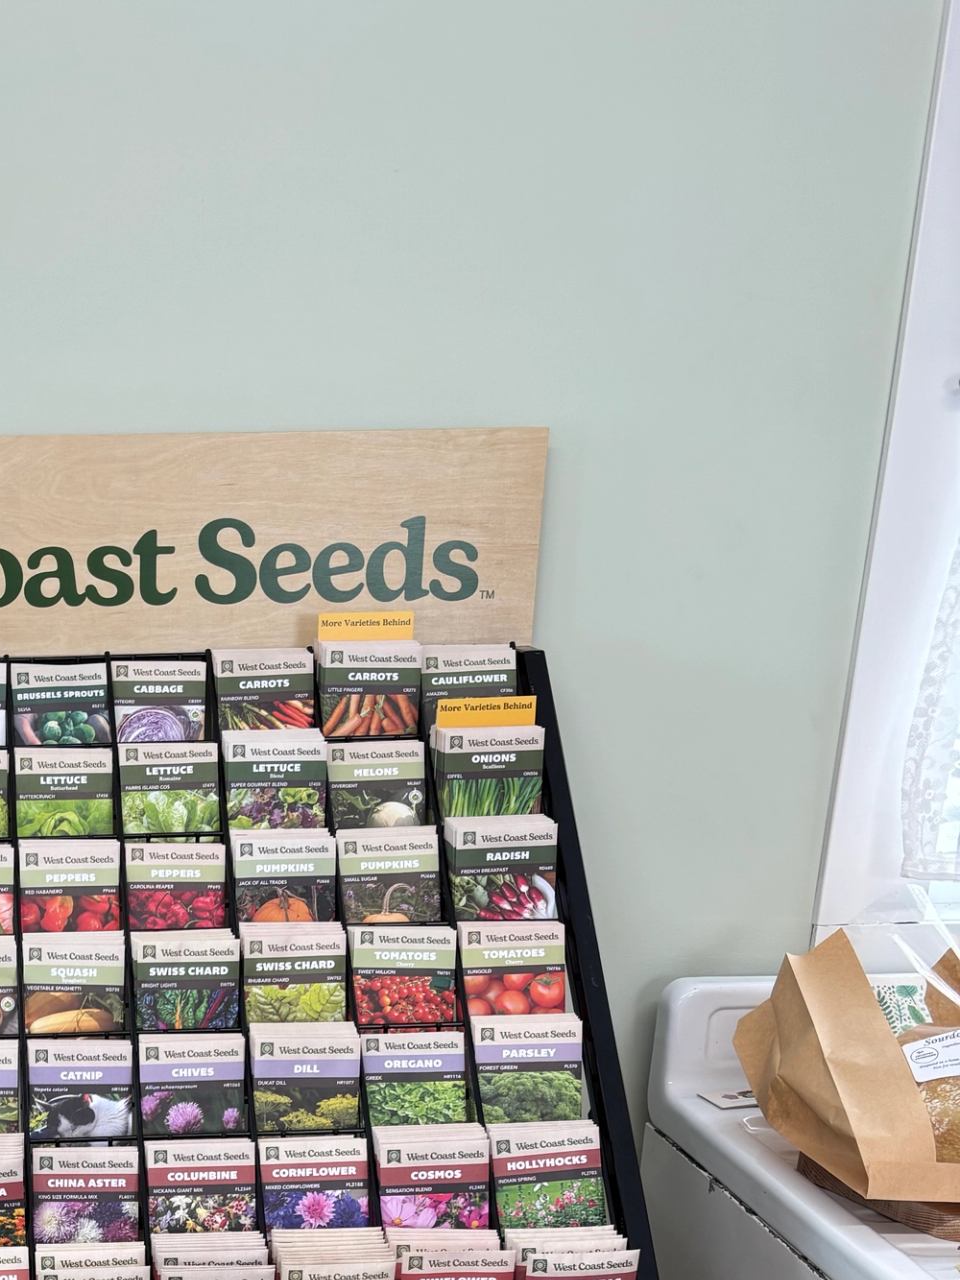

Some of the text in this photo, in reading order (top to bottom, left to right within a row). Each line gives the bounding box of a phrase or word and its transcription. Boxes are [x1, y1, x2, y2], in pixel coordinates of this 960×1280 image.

[195, 516, 479, 605] Seeds
[344, 619, 380, 627] Varieties
[383, 618, 411, 626] Behind
[348, 672, 399, 681] CARROTS
[432, 674, 507, 685] CAULIFLOWER
[134, 685, 183, 693] CABBAGE
[17, 689, 104, 700] BRUSSELS SPROUTS
[471, 753, 516, 763] ONIONS
[146, 765, 193, 775] LETTUCE
[253, 763, 301, 772] LETTUCE
[354, 767, 399, 777] MELONS
[486, 851, 529, 861] RADISH
[256, 863, 314, 873] PUMPKINS
[46, 873, 96, 883] PEPPERS
[374, 951, 436, 960] TOMATOES
[149, 966, 228, 976] SWISS CHARD
[503, 1048, 556, 1058] PARSLEY
[294, 1064, 320, 1073] DILL
[384, 1059, 442, 1068] OREGANO
[60, 1071, 103, 1080] CATNIP
[172, 1067, 214, 1077] CHIVES
[507, 1155, 587, 1171] HOLLYHOCKS
[167, 1171, 237, 1181] COLUMBINE
[272, 1166, 356, 1177] CORNFLOWER
[411, 1170, 462, 1180] COSMOS
[48, 1179, 126, 1187] CHINA ASTER
